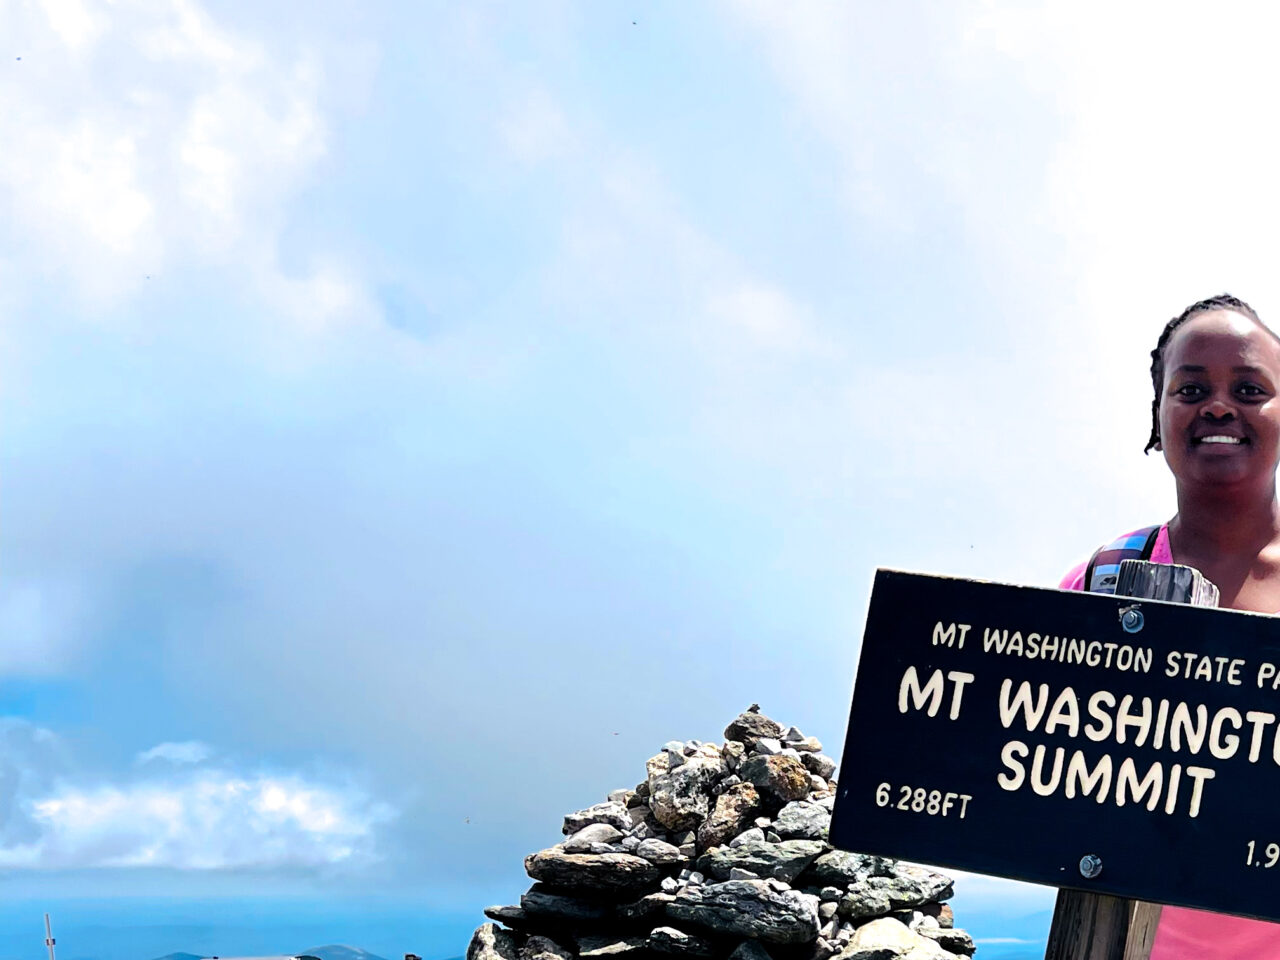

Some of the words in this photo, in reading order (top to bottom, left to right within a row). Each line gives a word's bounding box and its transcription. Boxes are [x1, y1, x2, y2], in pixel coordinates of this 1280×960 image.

[932, 621, 972, 649] MT
[983, 627, 1153, 673] WASHINGTON
[1165, 650, 1246, 686] STATE
[898, 665, 975, 721] MT
[875, 782, 973, 819] 6.288FT
[997, 740, 1216, 818] SUMMIT
